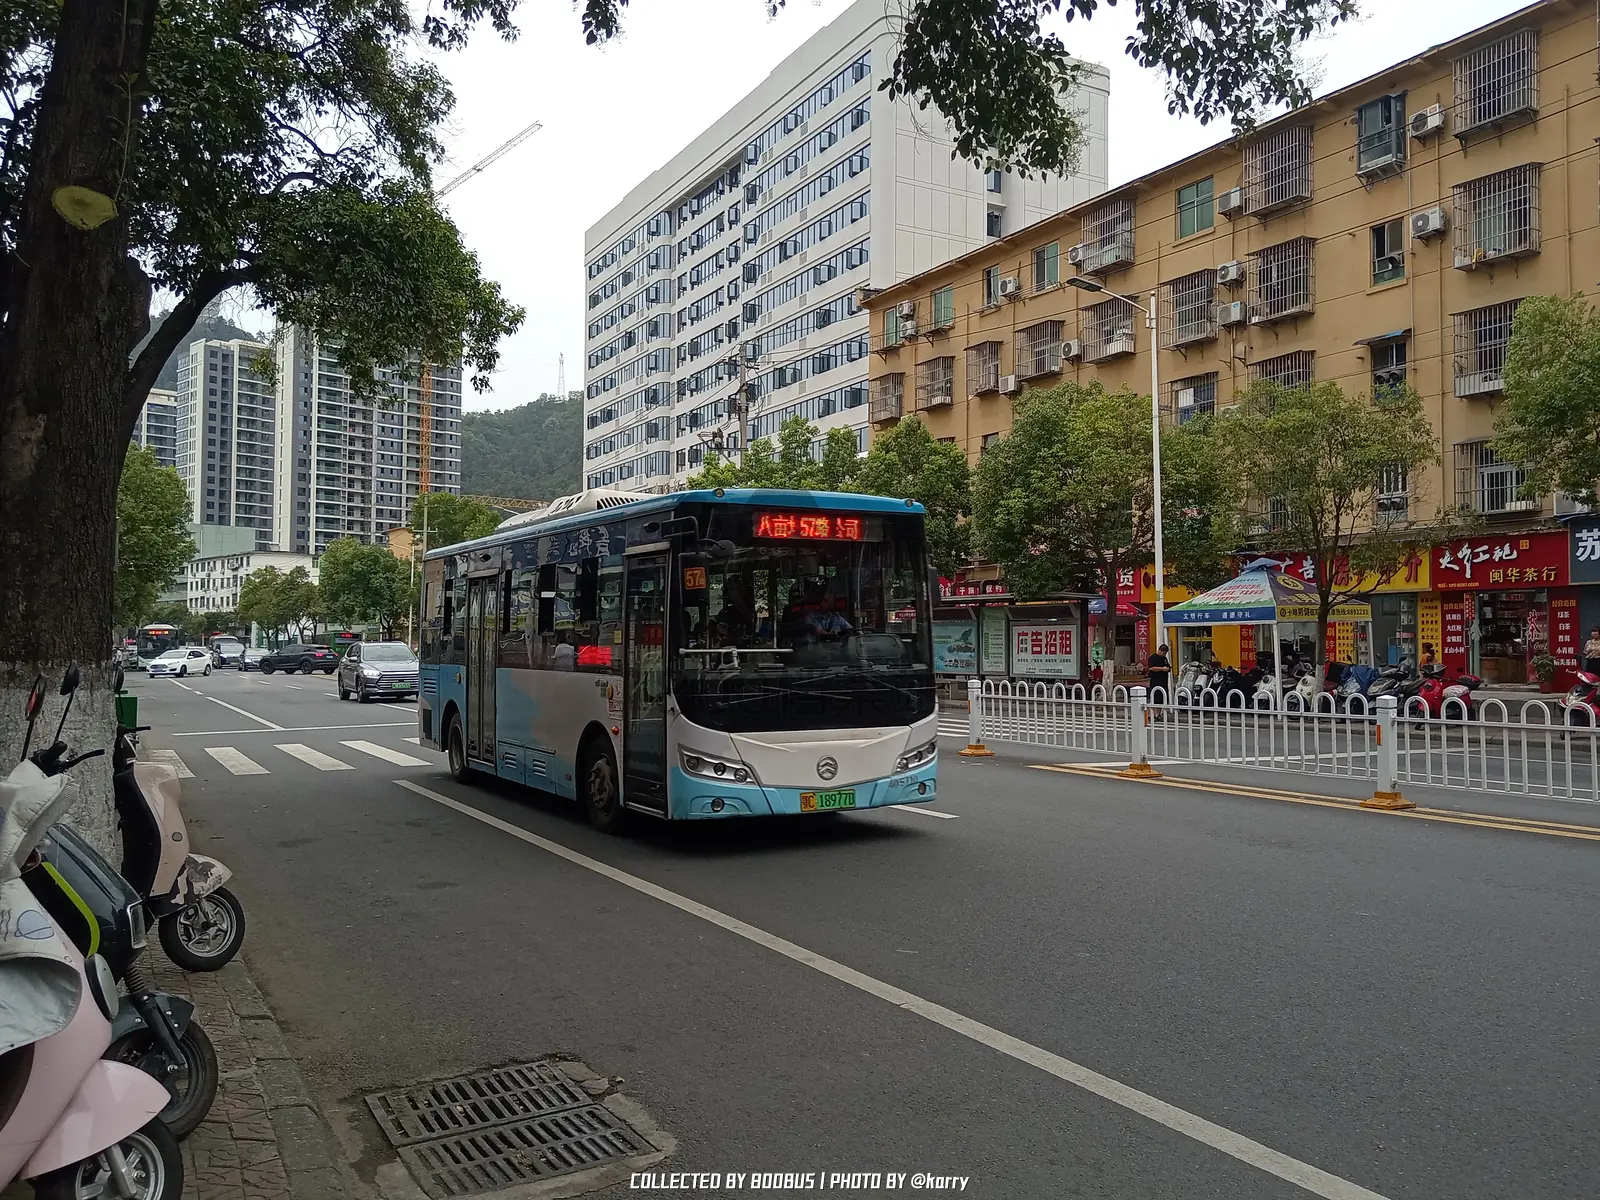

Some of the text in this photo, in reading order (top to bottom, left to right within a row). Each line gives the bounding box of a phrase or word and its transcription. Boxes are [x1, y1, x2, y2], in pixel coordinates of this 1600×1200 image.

[800, 516, 830, 537] 57路
[1575, 528, 1600, 562] 苏
[1489, 565, 1557, 584] 闽华茶行
[1017, 630, 1072, 655] 广告招租
